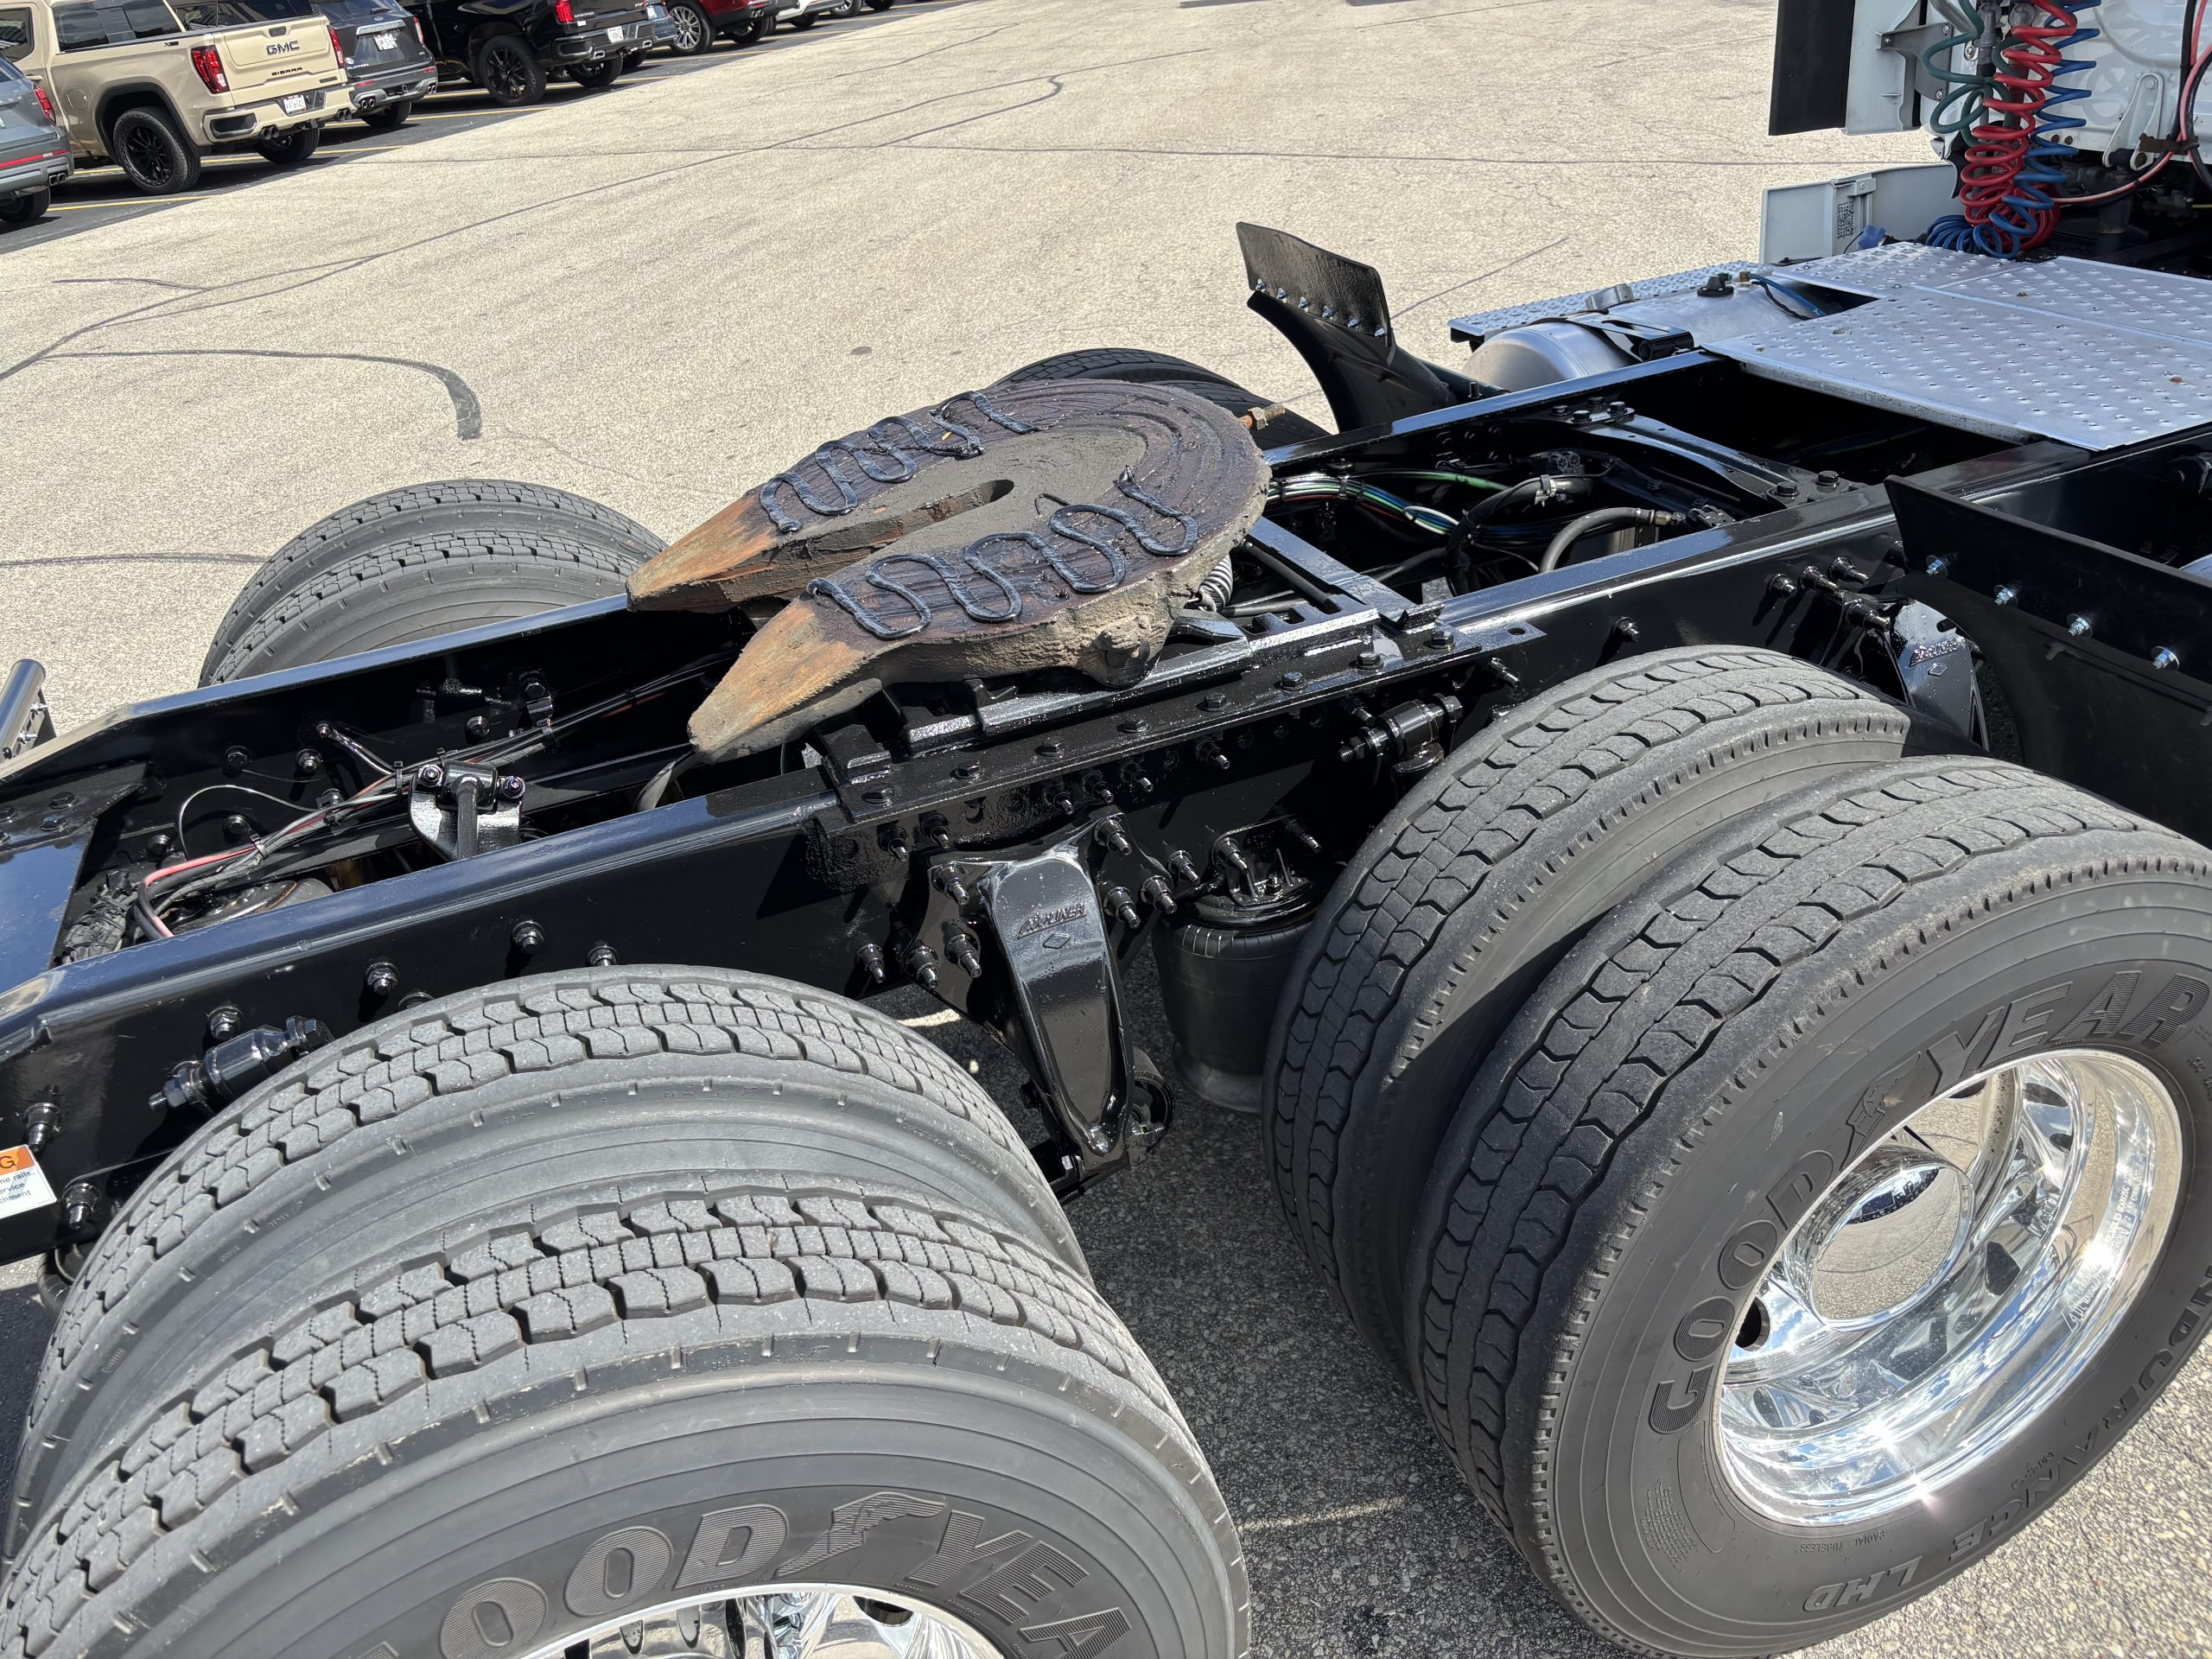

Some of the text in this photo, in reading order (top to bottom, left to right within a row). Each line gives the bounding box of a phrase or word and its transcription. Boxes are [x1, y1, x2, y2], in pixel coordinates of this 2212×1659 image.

[266, 41, 300, 55] GMC
[366, 1503, 789, 1659] OOD
[1802, 1555, 1923, 1613] LHD
